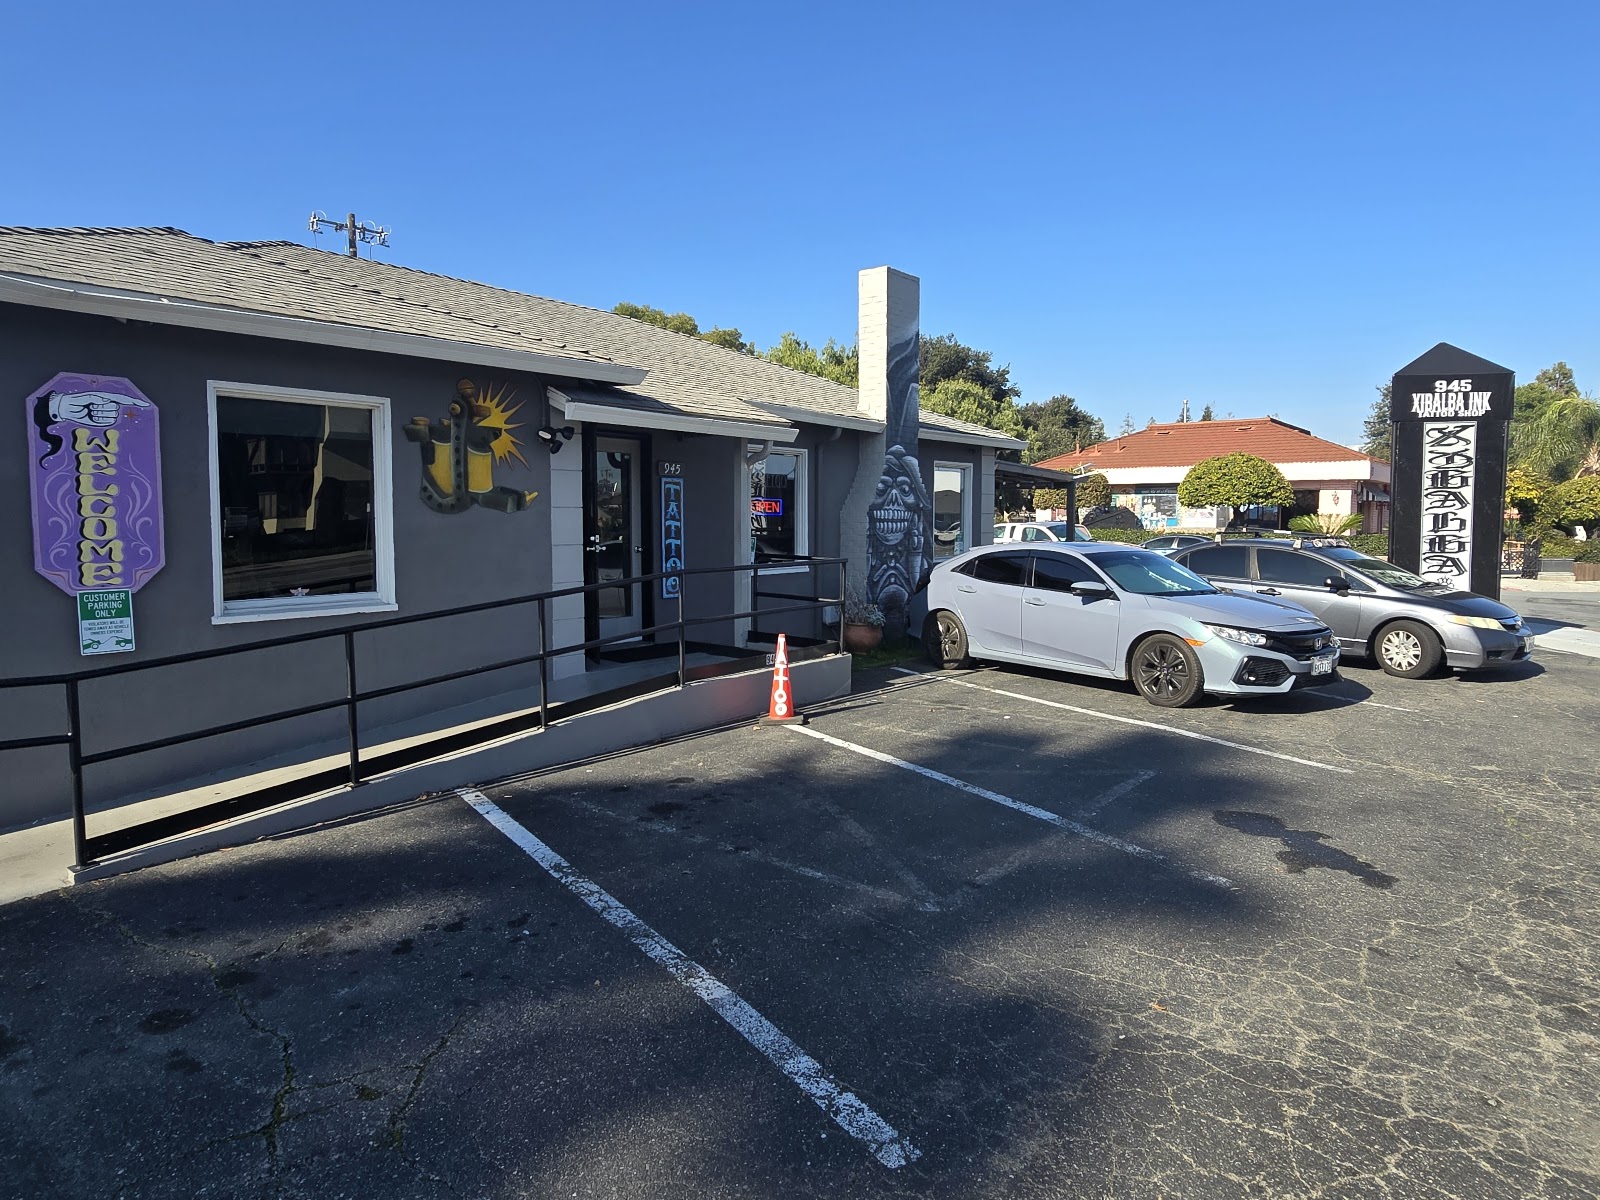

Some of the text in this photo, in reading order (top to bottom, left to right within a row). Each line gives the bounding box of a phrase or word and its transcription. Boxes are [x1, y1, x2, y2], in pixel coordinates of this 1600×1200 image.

[1434, 379, 1472, 392] 945
[1411, 391, 1492, 412] XIBALBA INK
[1417, 409, 1486, 418] TATTOO SHOP
[664, 463, 681, 475] 945
[73, 428, 124, 587] WELCOME
[665, 483, 681, 593] TATTOO
[83, 592, 126, 602] CUSTOMER
[87, 601, 123, 610] PARKING
[95, 609, 116, 618] ONLY
[766, 654, 776, 666] 94
[773, 637, 788, 716] TATTOO
